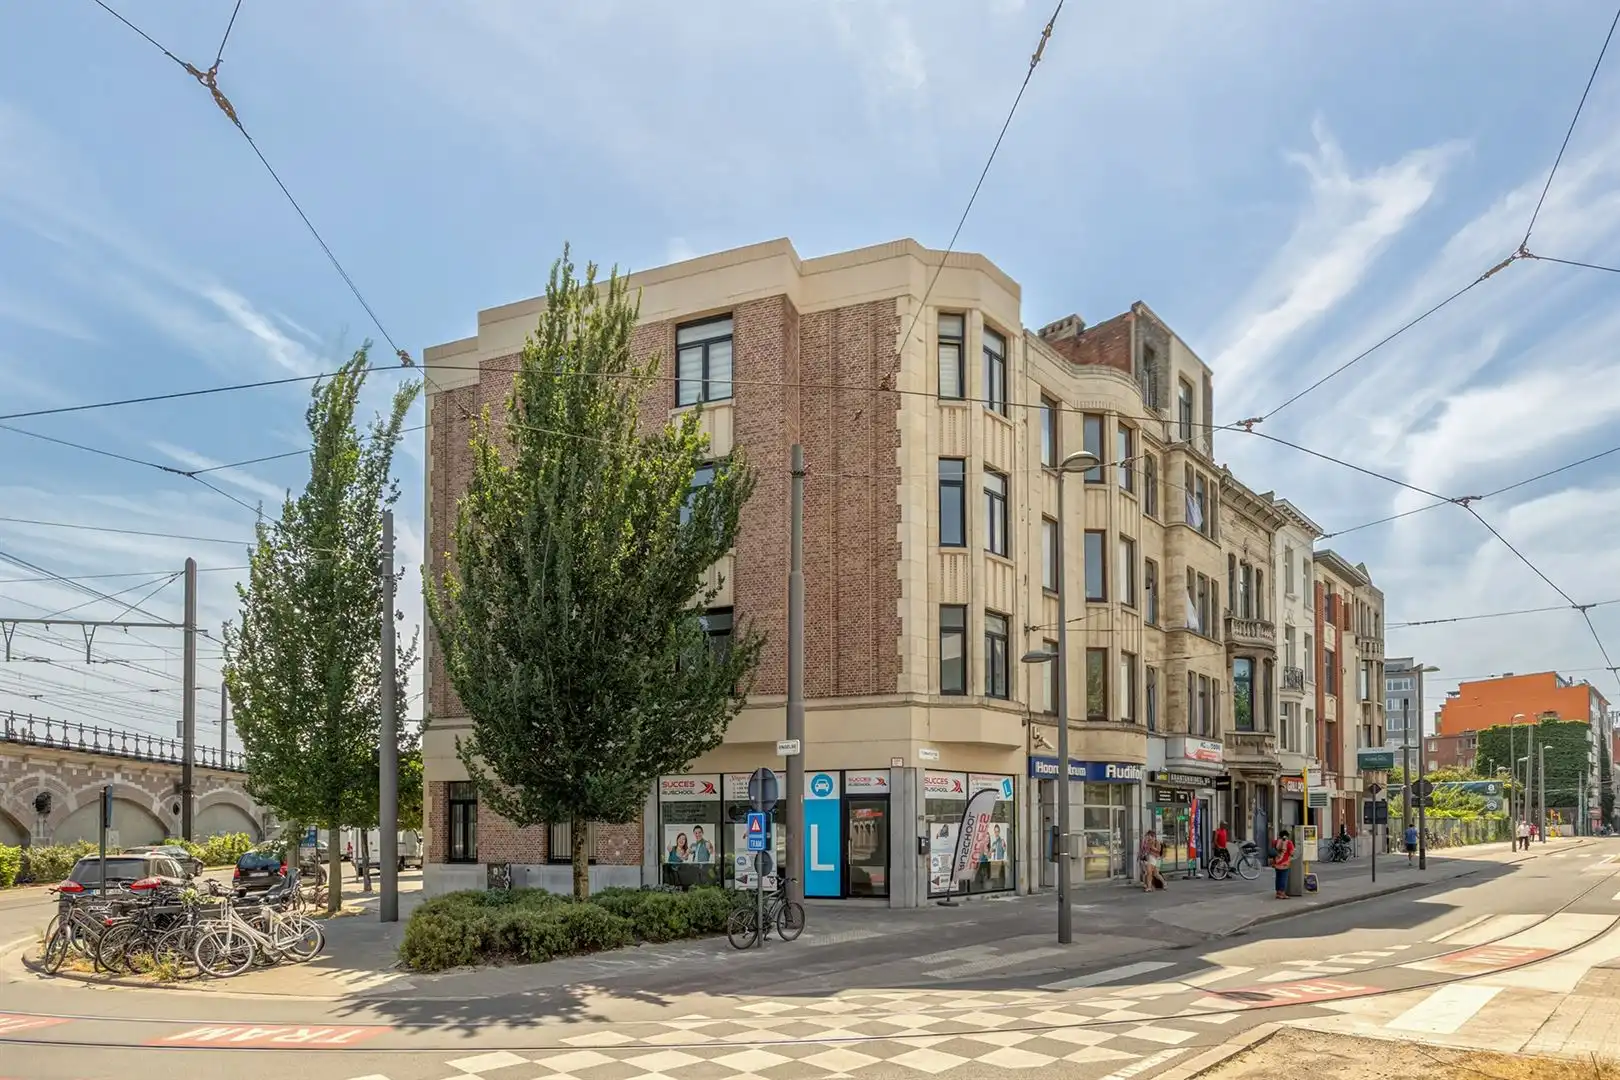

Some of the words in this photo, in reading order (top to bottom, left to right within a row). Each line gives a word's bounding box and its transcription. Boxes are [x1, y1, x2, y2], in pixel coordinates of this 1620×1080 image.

[662, 780, 695, 788] SUCCES
[924, 777, 949, 785] SUCCES
[750, 839, 762, 847] TRAM
[162, 1026, 367, 1044] TRAM
